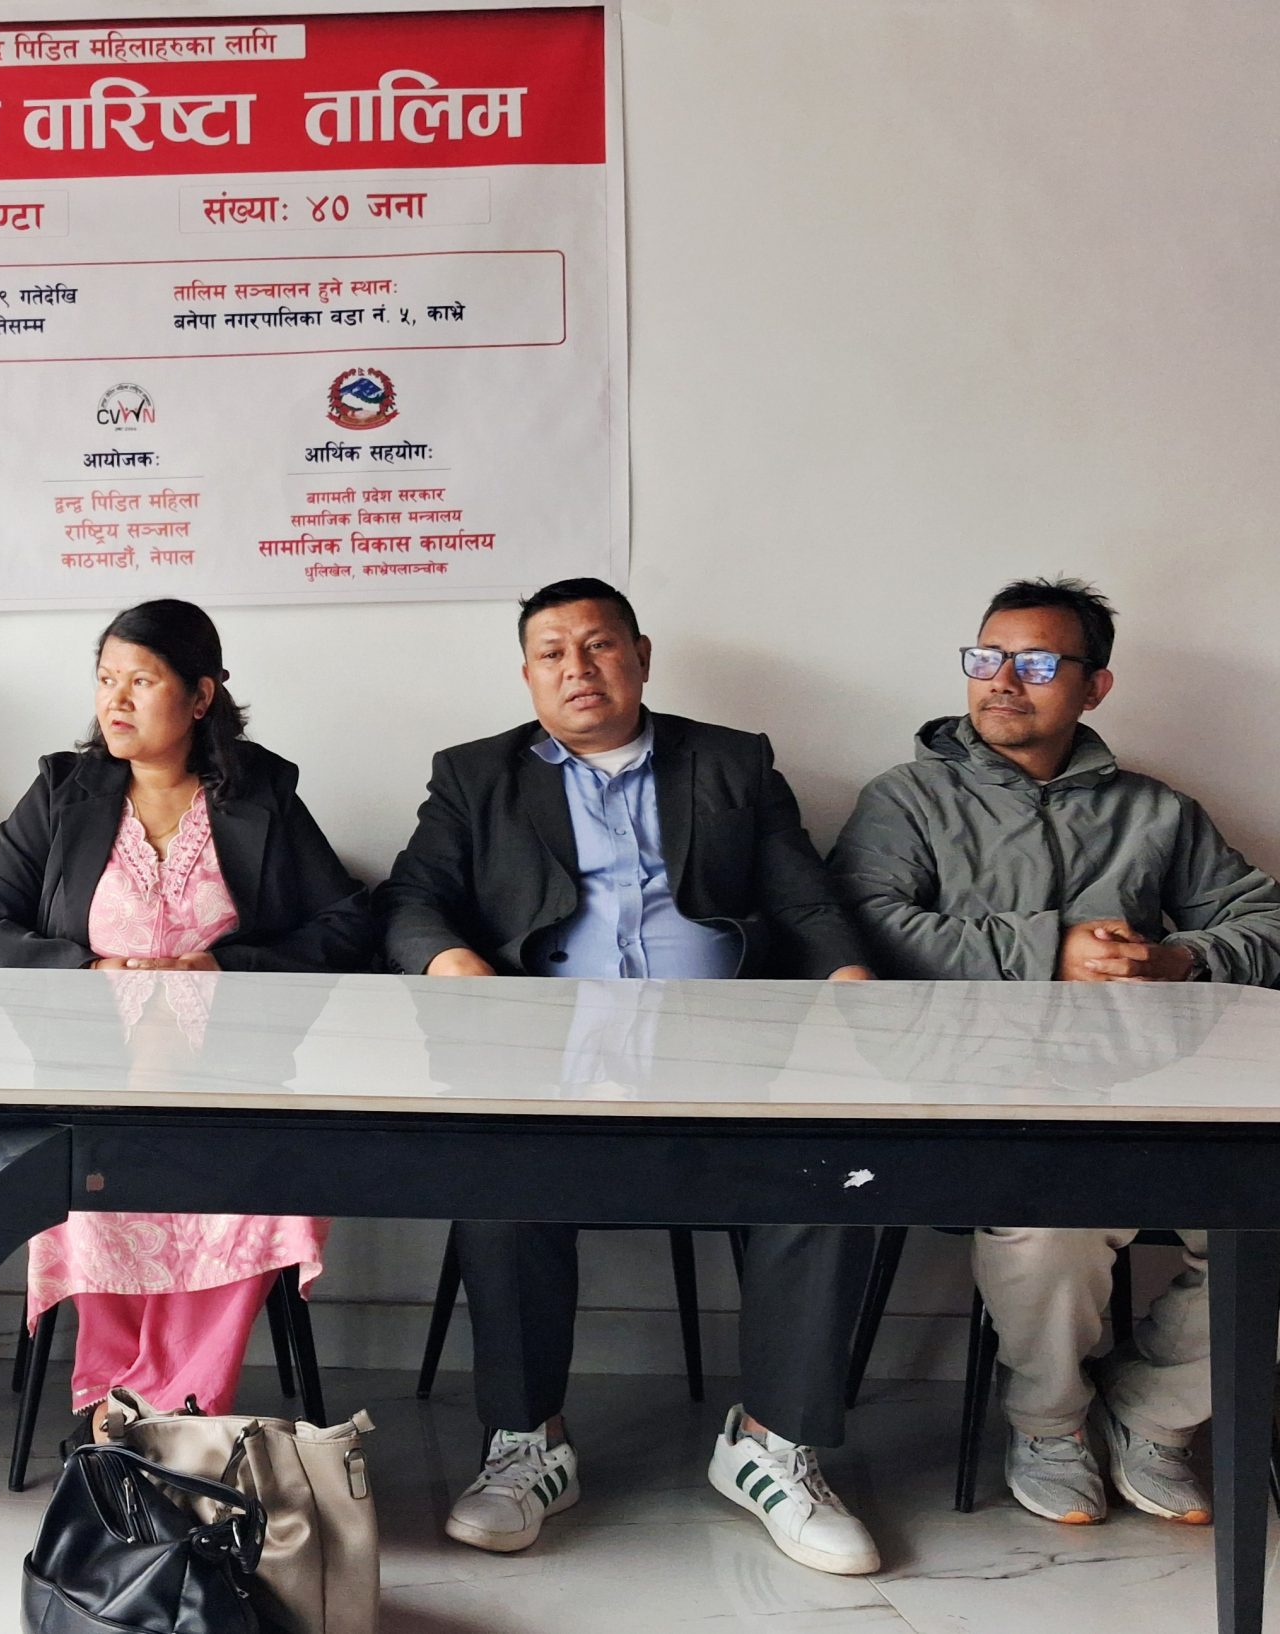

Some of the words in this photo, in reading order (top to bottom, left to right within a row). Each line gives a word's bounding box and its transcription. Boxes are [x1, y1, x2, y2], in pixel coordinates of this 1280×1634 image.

[13, 31, 80, 61] पिडित
[88, 29, 217, 63] महिलाहरुका
[223, 25, 277, 54] लागि
[304, 69, 527, 145] तालिम
[307, 195, 349, 222] ४०
[367, 193, 427, 219] जना
[19, 283, 78, 305] गतेदेखि
[174, 280, 227, 300] तालिम
[234, 283, 311, 299] सञ्चालन
[319, 278, 343, 303] हुने
[174, 310, 216, 329] बनेपा
[224, 306, 323, 329] नगरपालिका
[330, 309, 364, 326] वडा
[427, 301, 465, 321] काभ्रे
[305, 441, 362, 462] आर्थिक
[54, 497, 84, 513] द्वन्द्व
[91, 490, 141, 512] पिडित
[149, 488, 200, 512] महिला
[307, 487, 356, 504] बागमती
[362, 488, 392, 503] प्रदेश
[398, 489, 446, 502] सरकार
[291, 510, 352, 526] सामाजिक
[358, 509, 402, 524] विकास
[408, 510, 462, 523] मन्त्रालय
[64, 519, 120, 544] राष्ट्रिय
[127, 522, 191, 538] सञ्जाल
[258, 533, 342, 556] सामाजिक
[351, 532, 412, 553] विकास
[420, 529, 496, 552] कार्यालय
[150, 547, 195, 565] नेपाल
